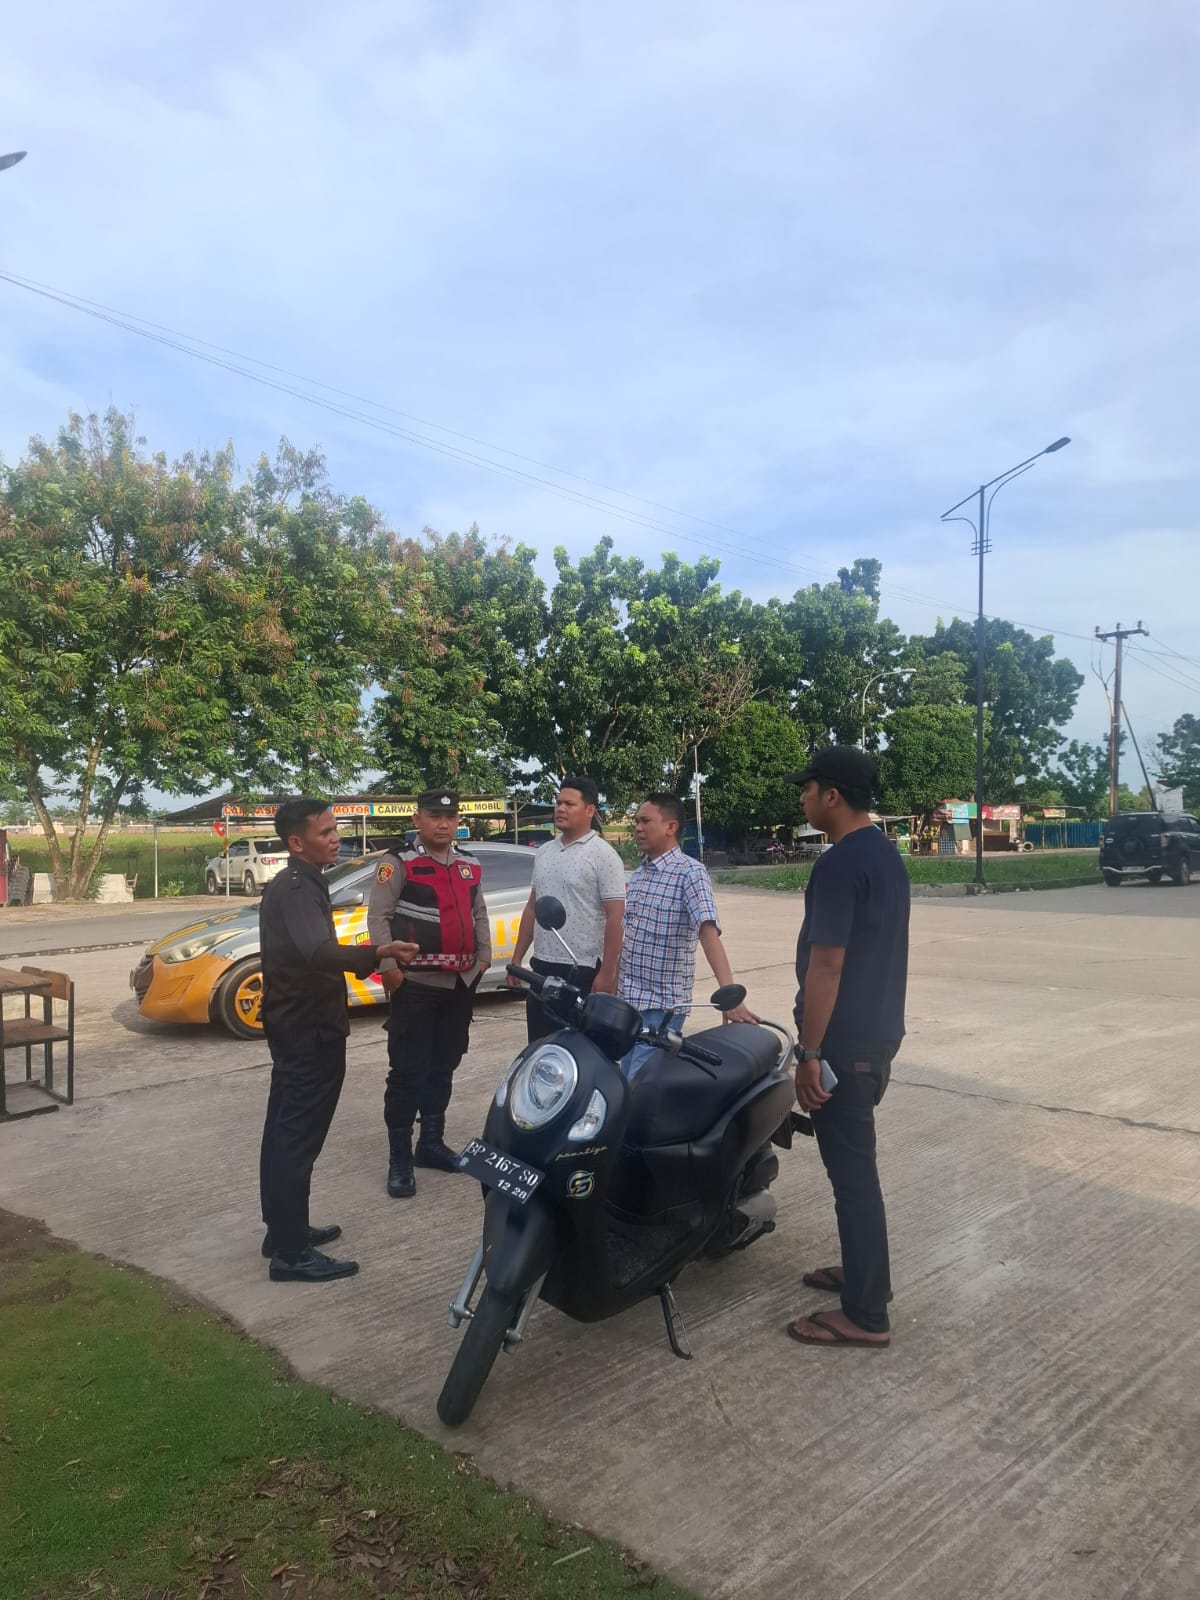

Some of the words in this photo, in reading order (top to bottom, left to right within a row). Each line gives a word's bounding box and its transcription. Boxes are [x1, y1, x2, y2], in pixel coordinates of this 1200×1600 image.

[333, 805, 369, 815] MOTOR
[378, 804, 418, 814] CARWAS
[474, 801, 502, 810] MOBIL
[467, 1141, 486, 1156] BP
[485, 1152, 520, 1175] 2167
[497, 1179, 511, 1191] 12
[511, 1187, 527, 1199] 28
